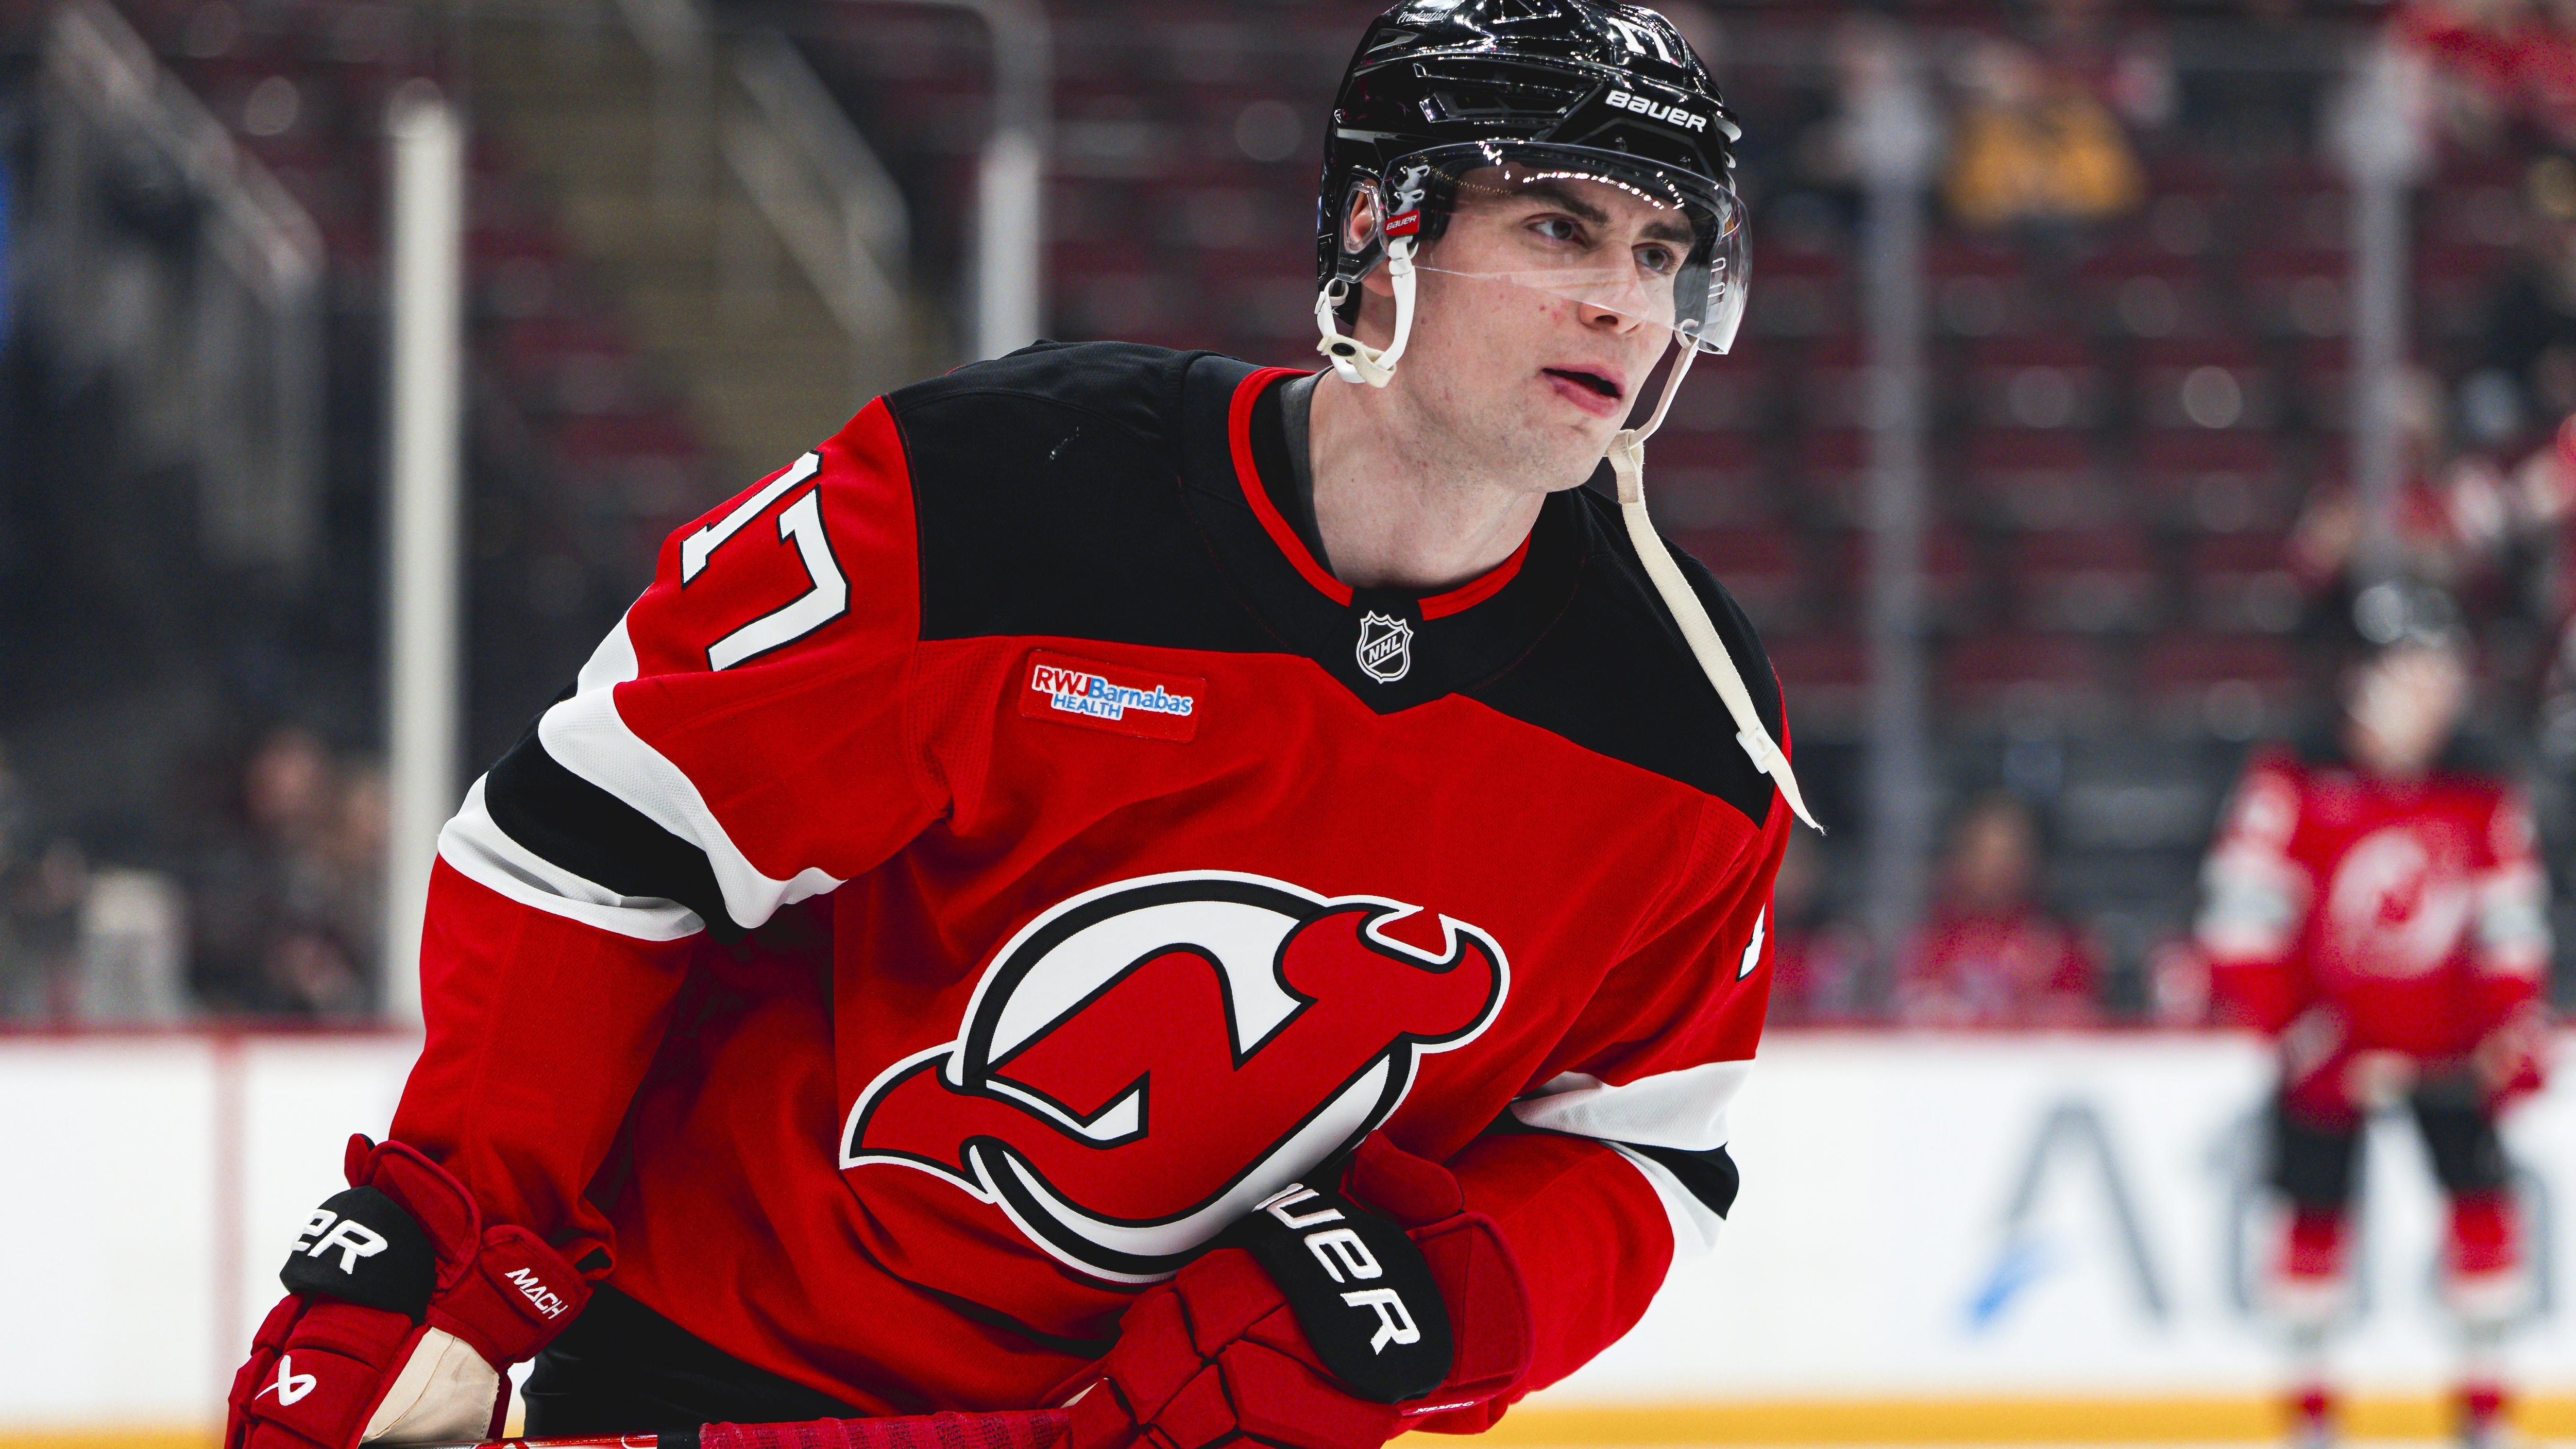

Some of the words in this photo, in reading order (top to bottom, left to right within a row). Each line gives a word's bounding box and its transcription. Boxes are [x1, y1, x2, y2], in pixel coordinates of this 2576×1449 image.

[1396, 9, 1450, 24] Prudential
[679, 449, 851, 672] 17
[1368, 635, 1401, 663] NHL
[1035, 668, 1192, 713] RWJBarnabas
[1054, 693, 1122, 718] HEALTH
[504, 1267, 569, 1319] MACH
